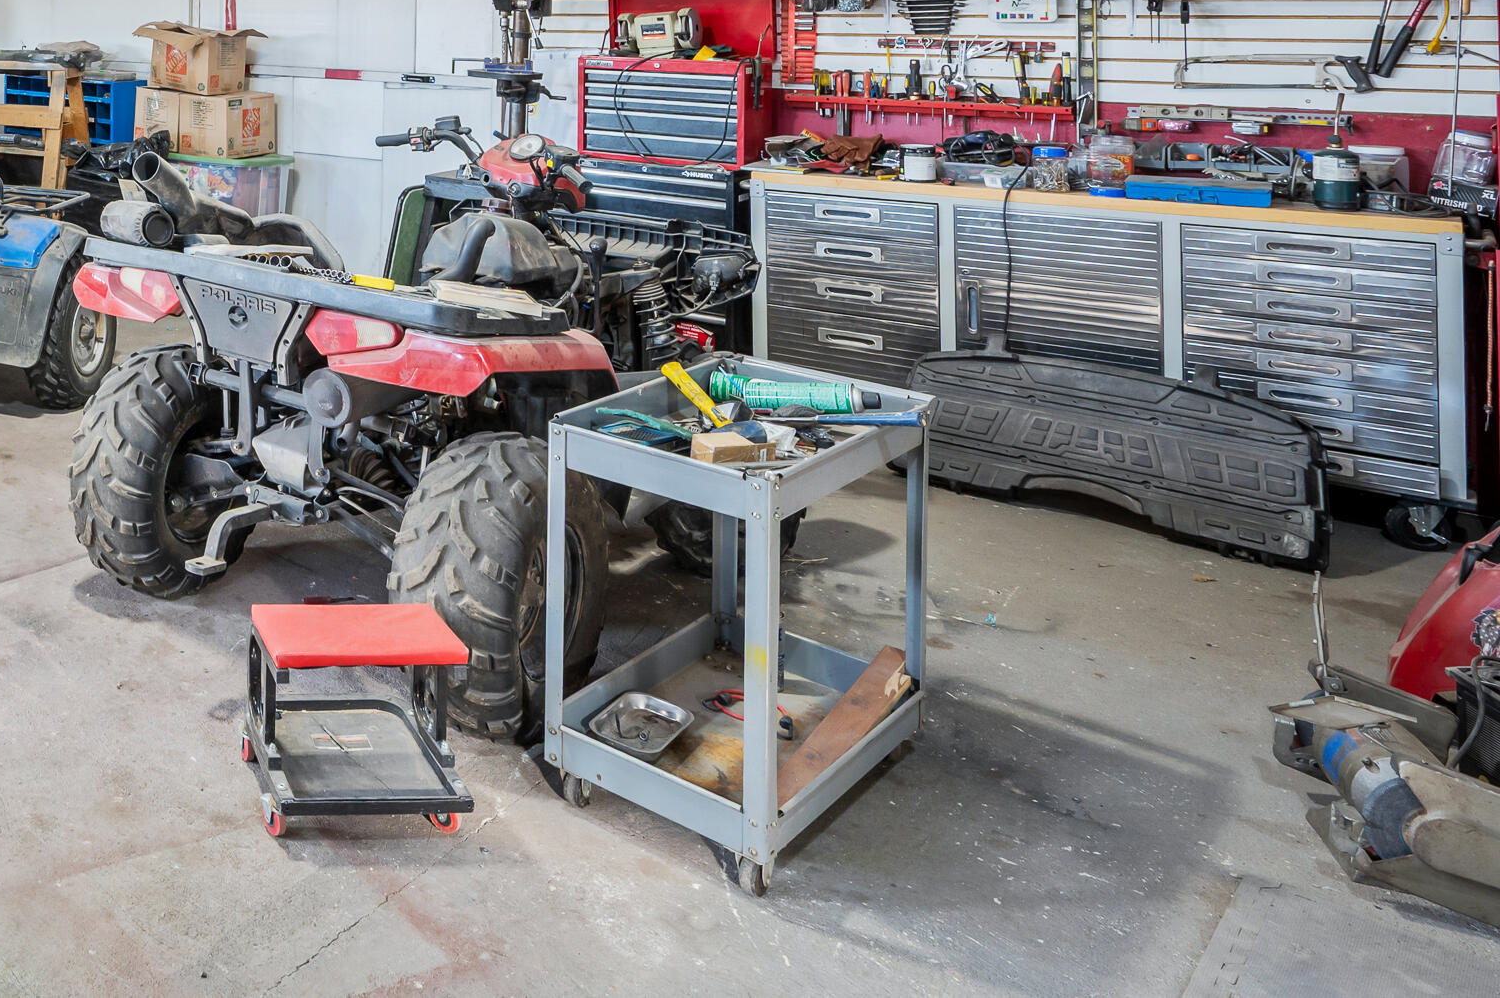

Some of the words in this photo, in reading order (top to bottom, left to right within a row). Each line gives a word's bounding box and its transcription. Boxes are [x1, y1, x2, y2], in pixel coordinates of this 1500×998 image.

[689, 171, 714, 180] HUSKY
[1481, 190, 1496, 200] XL
[1430, 196, 1483, 212] NITRISHID
[199, 284, 277, 314] POLARIS
